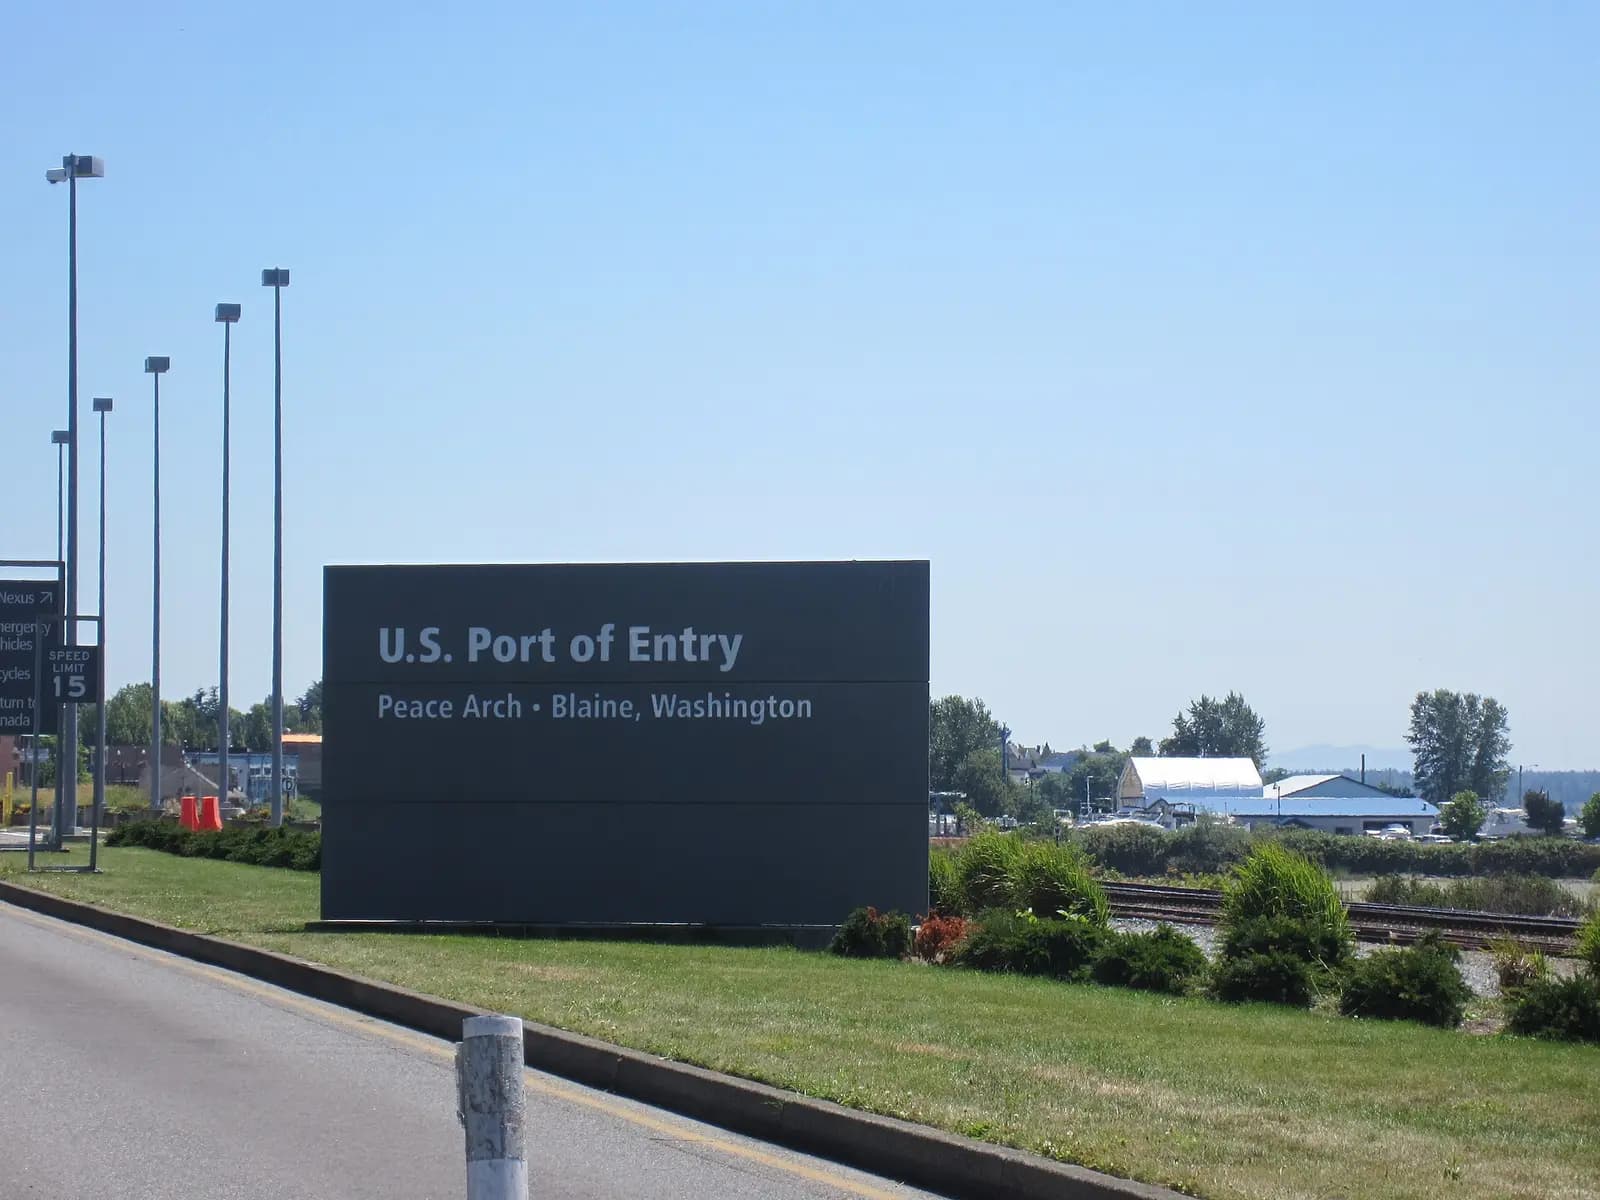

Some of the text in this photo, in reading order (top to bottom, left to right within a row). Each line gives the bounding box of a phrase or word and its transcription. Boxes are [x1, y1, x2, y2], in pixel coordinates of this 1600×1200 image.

[49, 651, 90, 661] SPEED
[378, 623, 744, 672] U.S. Port of Entry
[53, 663, 85, 673] LIMIT
[53, 675, 86, 698] 15
[378, 692, 812, 725] Peace Arch Blaine, Washington
